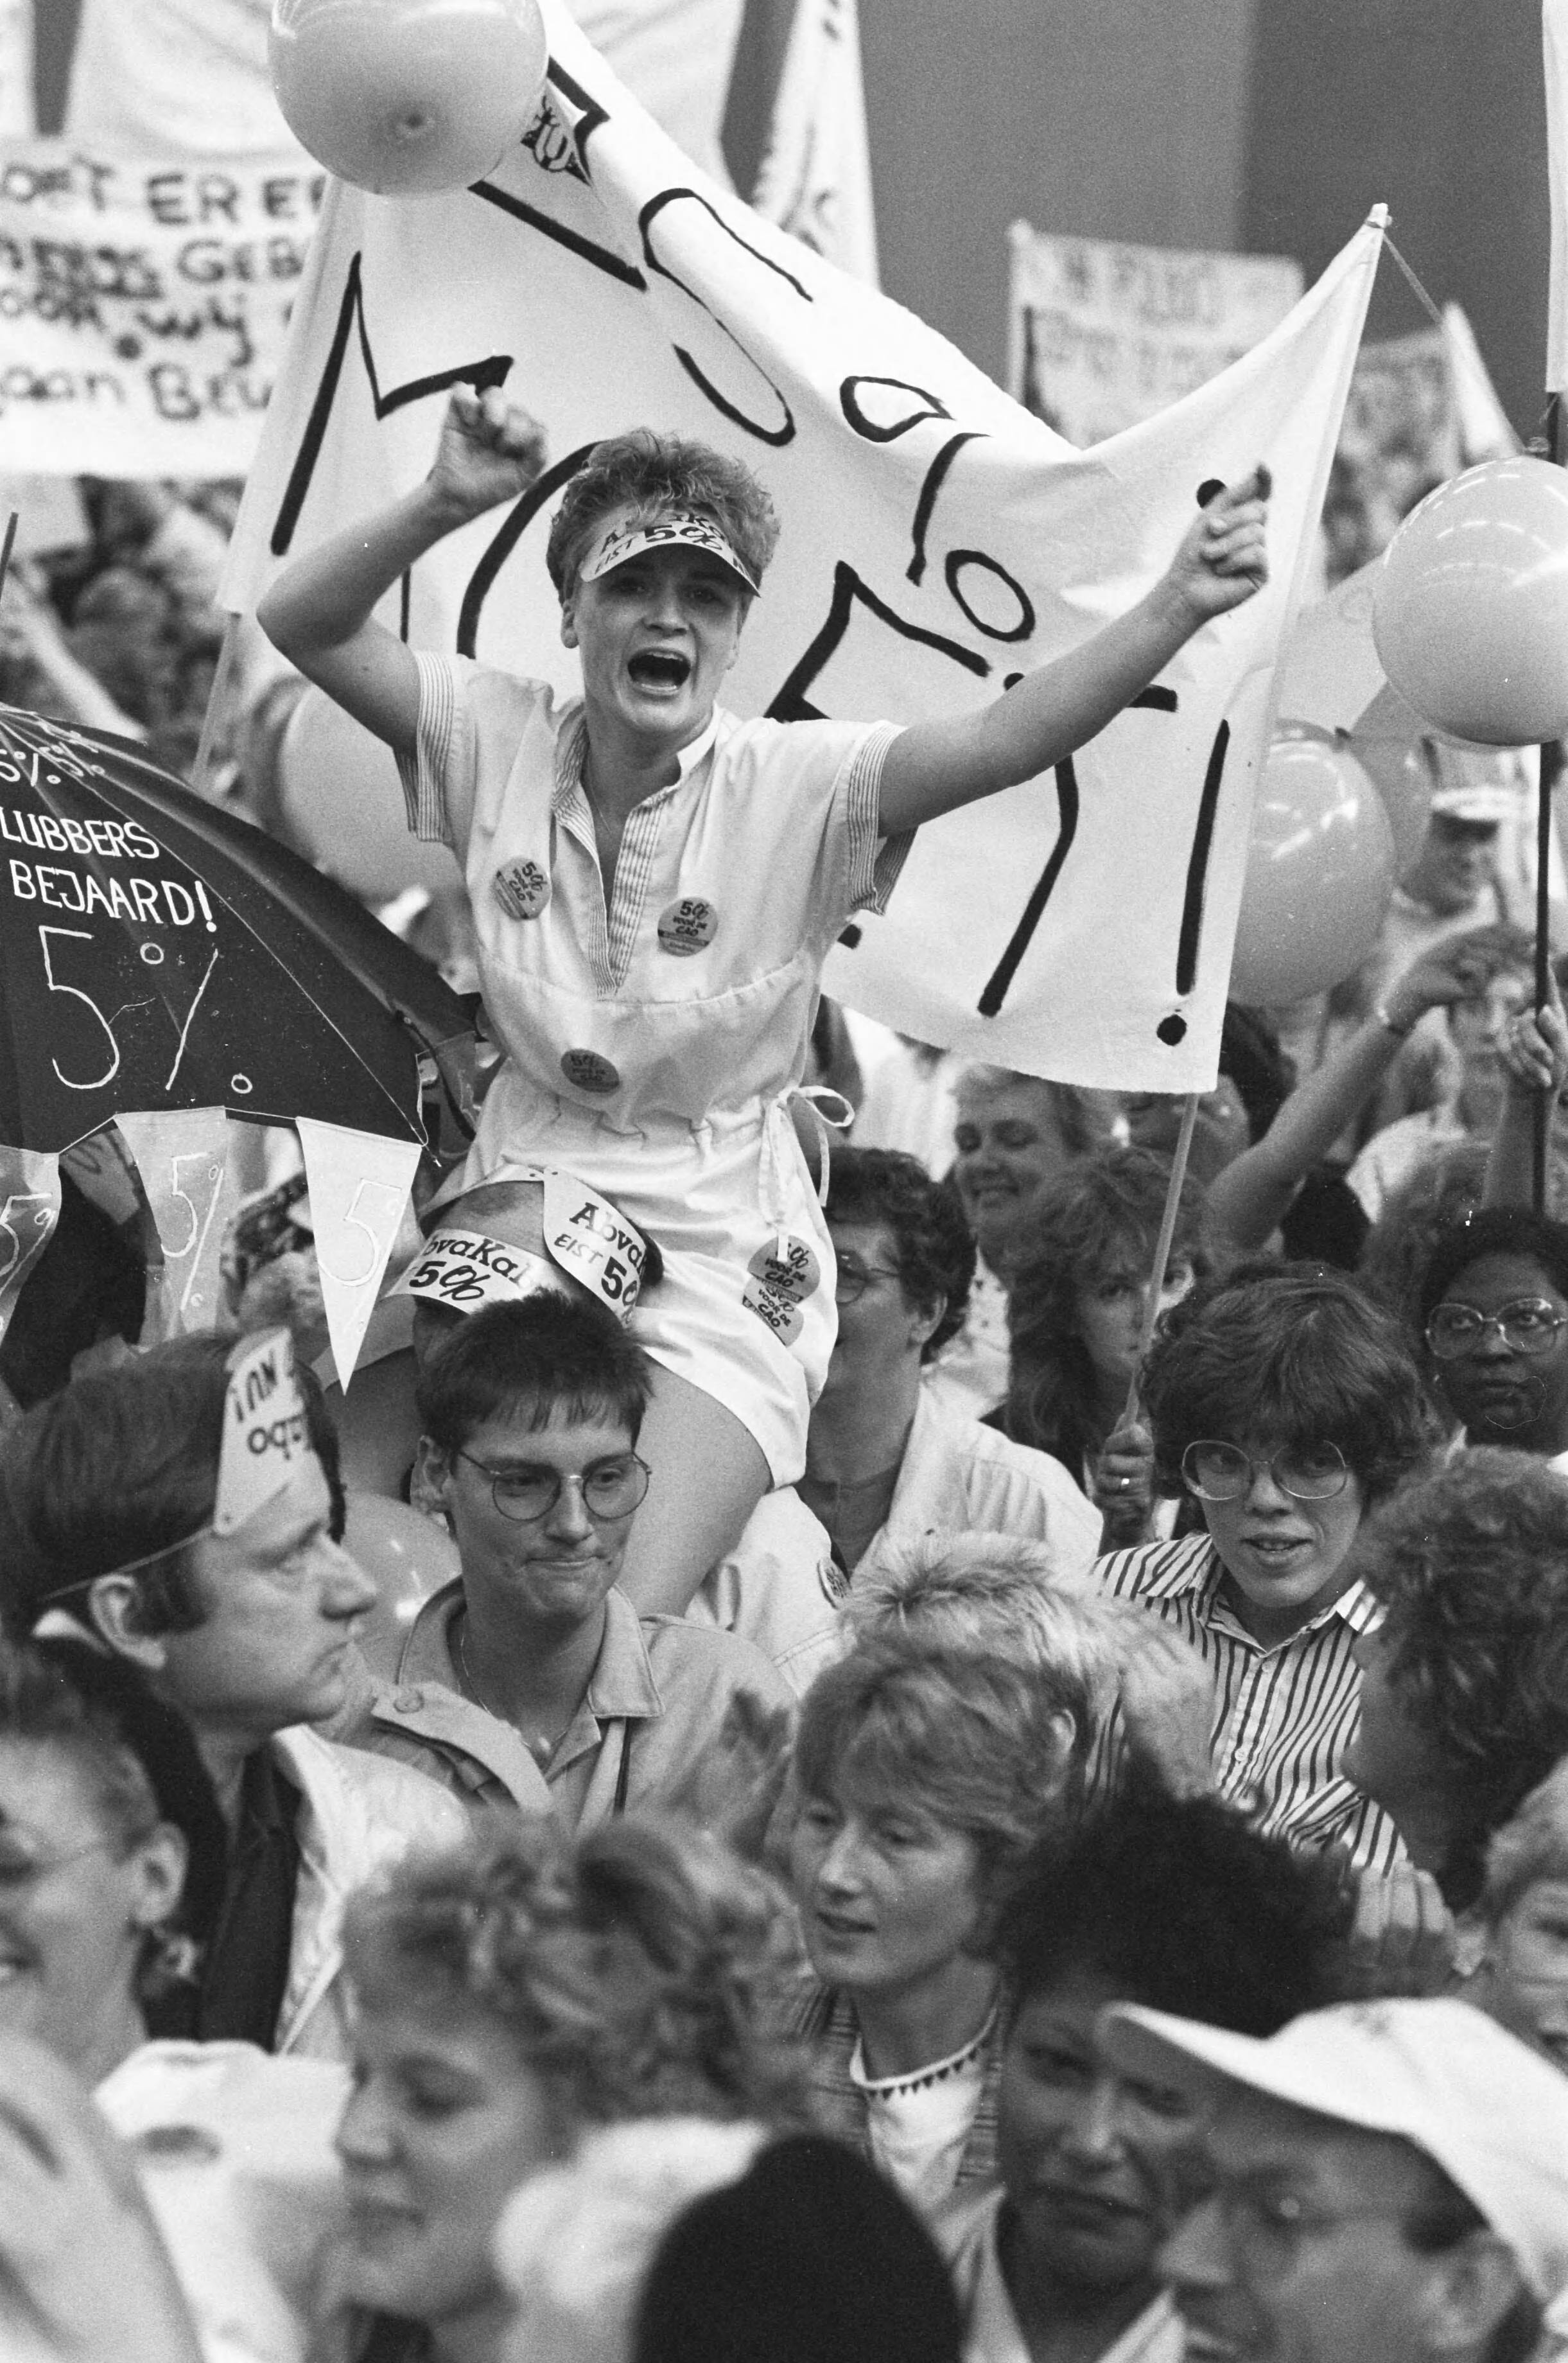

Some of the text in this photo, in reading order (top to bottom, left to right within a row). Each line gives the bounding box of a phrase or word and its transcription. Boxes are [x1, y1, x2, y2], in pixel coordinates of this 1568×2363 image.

[0, 807, 159, 859] LUBBERS
[521, 861, 548, 892] 5%
[9, 859, 217, 933] BEJAARD!
[680, 901, 710, 920] 5%
[675, 926, 699, 936] CAO
[39, 925, 253, 1094] 5%
[554, 1233, 604, 1264] EIST
[569, 1202, 644, 1276] Abva
[409, 1260, 491, 1301] 5%
[765, 1271, 794, 1287] CAO
[758, 1288, 780, 1314] VOOR
[758, 1303, 781, 1328] CAO
